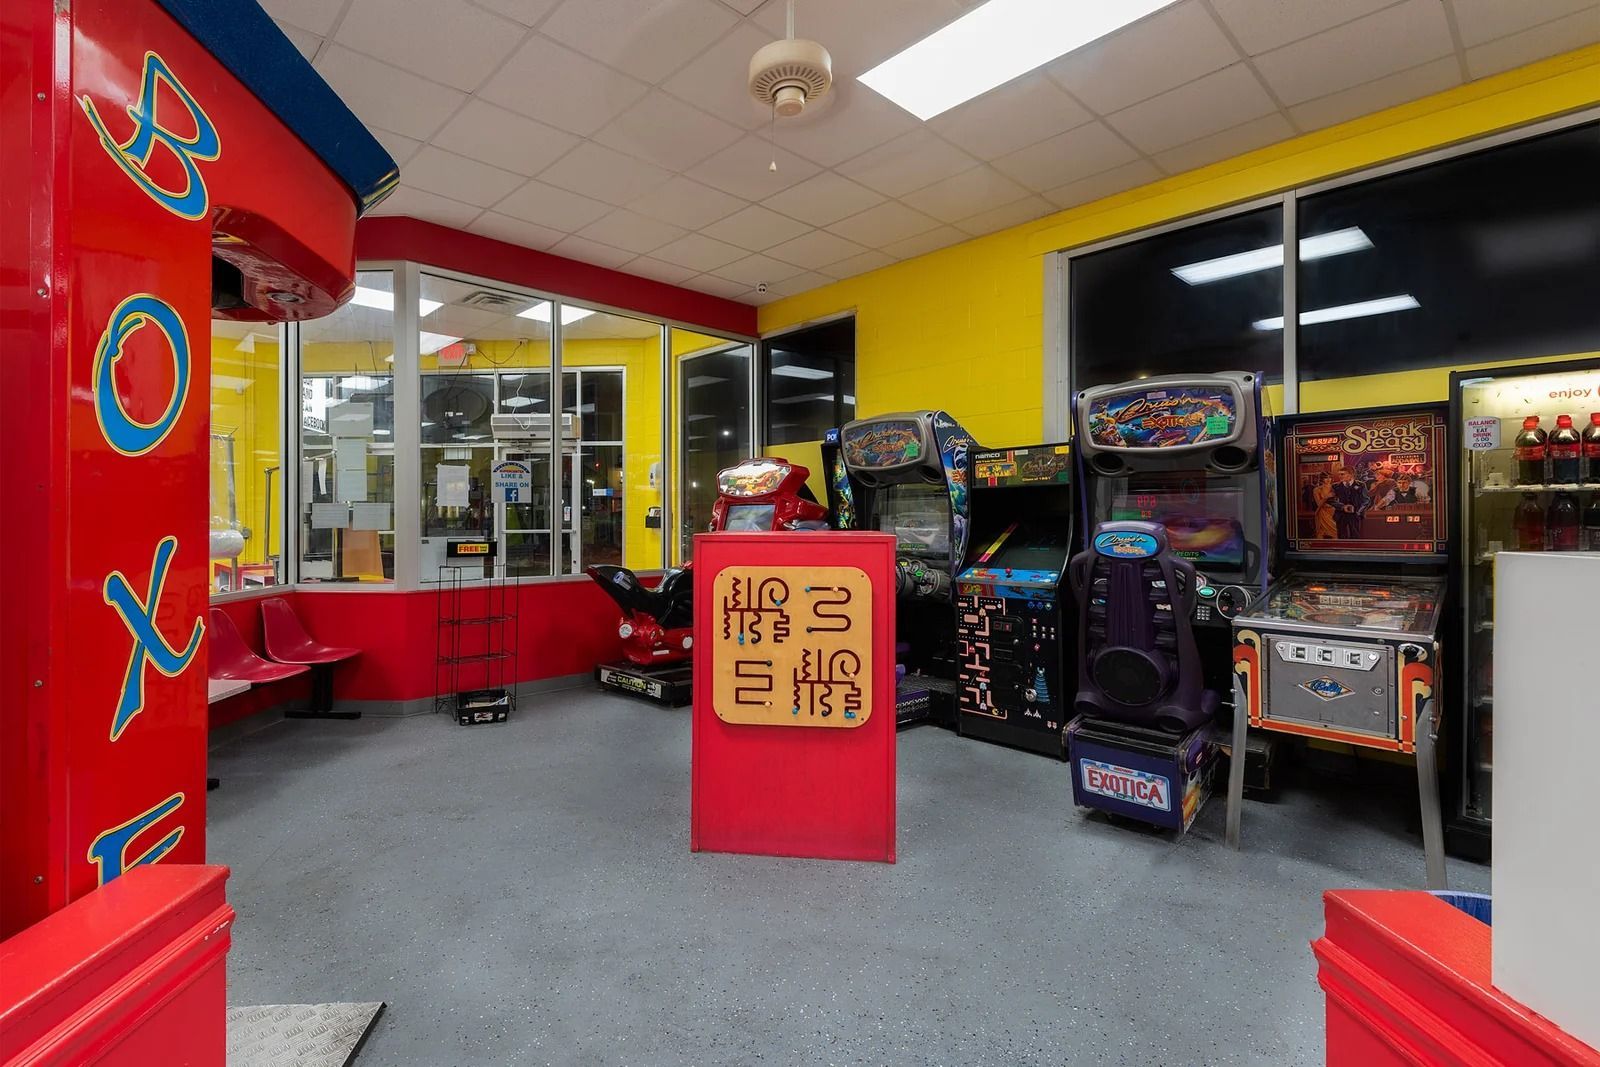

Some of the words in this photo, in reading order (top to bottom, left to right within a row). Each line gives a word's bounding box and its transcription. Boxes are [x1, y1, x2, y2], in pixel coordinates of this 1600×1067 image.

[1549, 388, 1592, 399] enjoy
[303, 415, 326, 430] ACEBOOK
[1468, 419, 1497, 427] BALANCE
[1343, 421, 1422, 453] Speak
[975, 452, 1001, 460] namco
[458, 545, 480, 553] FREE
[617, 675, 647, 690] CAUTION
[1087, 769, 1164, 804] EXOTICA
